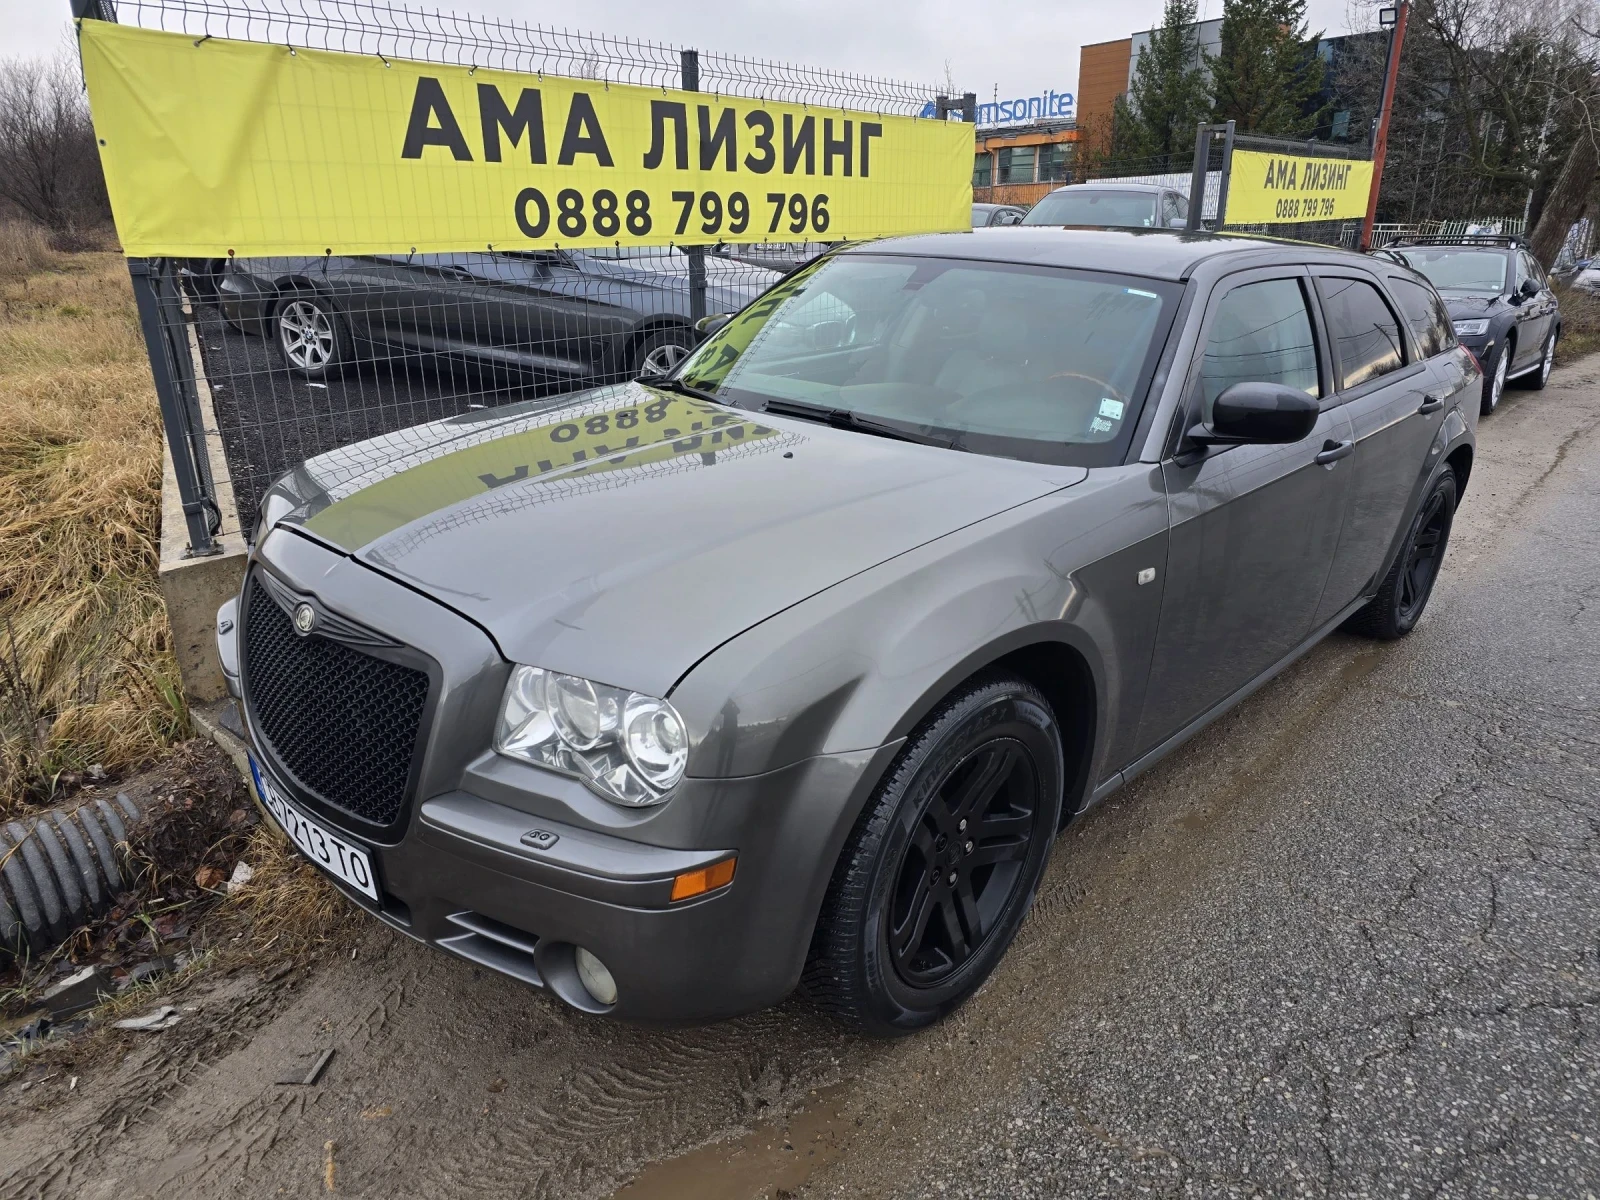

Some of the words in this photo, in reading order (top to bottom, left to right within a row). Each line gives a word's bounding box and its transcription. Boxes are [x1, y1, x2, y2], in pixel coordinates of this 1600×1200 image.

[953, 91, 1074, 126] msonite
[402, 77, 614, 168] АМА
[643, 100, 883, 178] ЛИЗИНГ
[1263, 159, 1297, 190] АМА
[1300, 163, 1352, 191] ЛИЗИНГ
[514, 187, 652, 239] 0888
[671, 191, 750, 237] 799
[766, 193, 830, 234] 796
[1275, 199, 1299, 219] 0888
[1301, 198, 1318, 217] 799
[1319, 197, 1334, 216] 796
